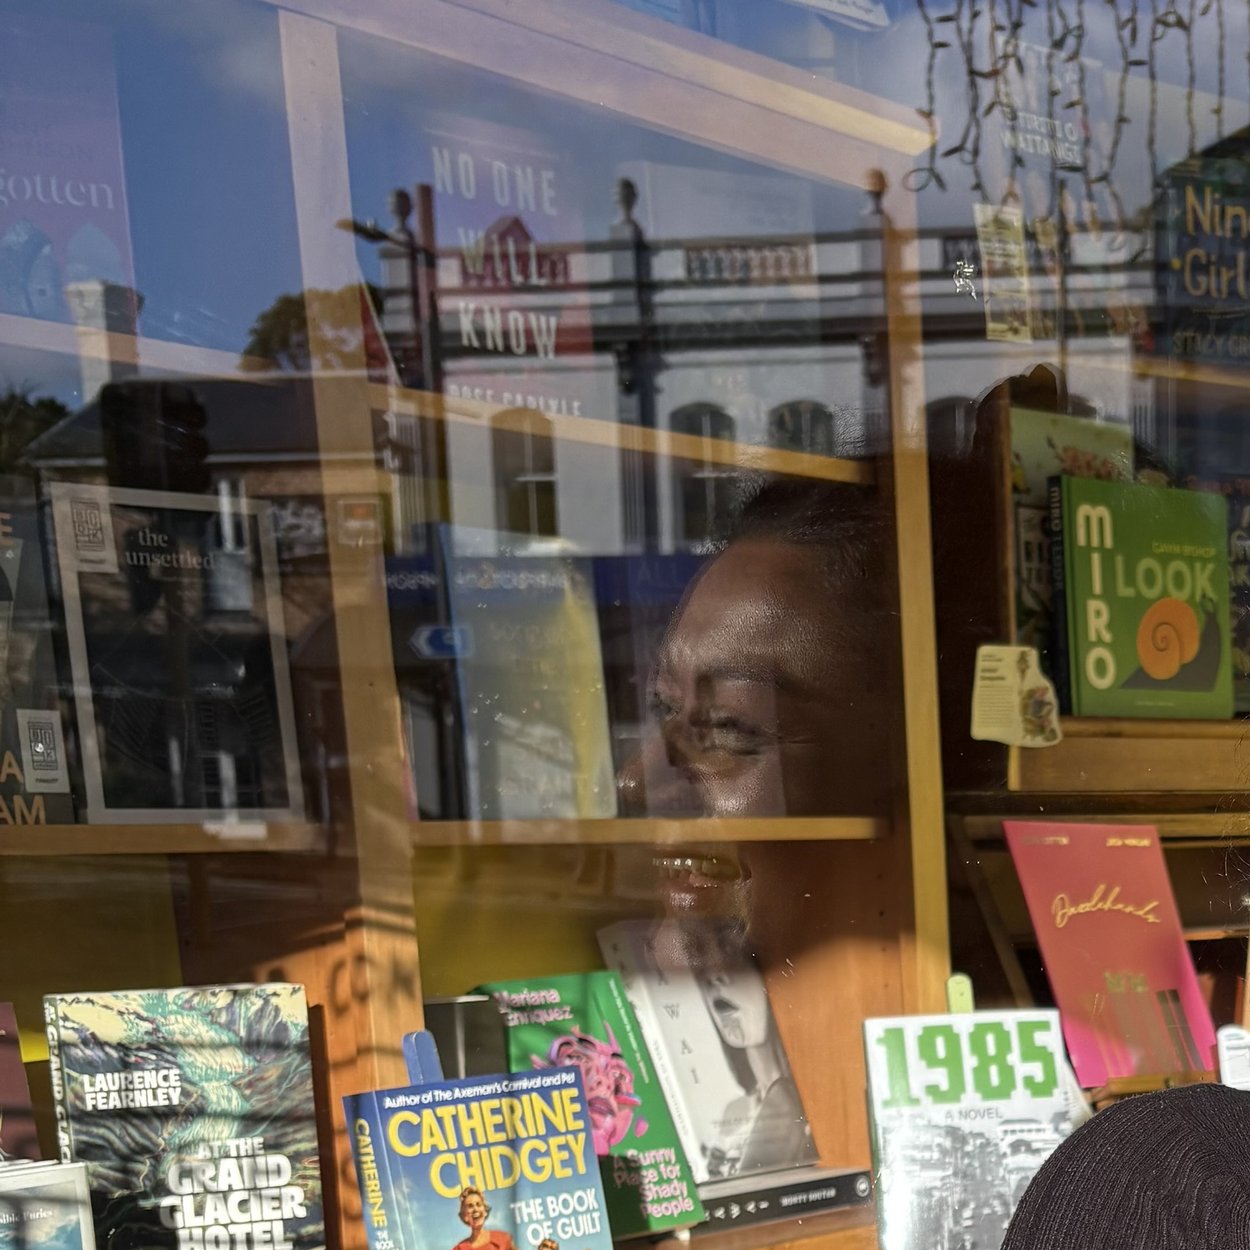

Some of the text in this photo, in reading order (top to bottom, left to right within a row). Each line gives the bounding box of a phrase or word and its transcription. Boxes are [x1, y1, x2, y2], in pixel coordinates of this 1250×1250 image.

[432, 146, 558, 216] NO ONE
[458, 227, 546, 286] WILL
[458, 300, 558, 359] KNOW
[138, 528, 168, 548] the
[126, 549, 215, 571] unsettled
[1115, 554, 1216, 602] LOOK
[498, 988, 560, 1009] Mariana
[82, 1067, 181, 1093] LAURENCE
[876, 1021, 1059, 1108] 1985
[85, 1086, 182, 1111] FEARNLEY
[384, 1092, 418, 1109] Author
[420, 1090, 433, 1104] of
[433, 1087, 453, 1102] The
[453, 1080, 501, 1100] Axeman's
[502, 1075, 541, 1094] Carnival
[542, 1073, 560, 1088] and
[387, 1088, 585, 1158] CATHERINE
[945, 1107, 1003, 1121] A NOVEL
[199, 1136, 264, 1158] AT THE
[628, 1147, 676, 1167] Sunny
[168, 1155, 292, 1196] GRAND
[354, 1117, 388, 1229] CATHERINE
[429, 1132, 587, 1199] CHIDGEY
[615, 1162, 682, 1188] Place for
[160, 1186, 307, 1228] GLACIER
[510, 1188, 599, 1226] THE BOOK
[640, 1181, 688, 1202] Shady
[641, 1197, 694, 1219] People
[527, 1211, 602, 1247] OF GUILT
